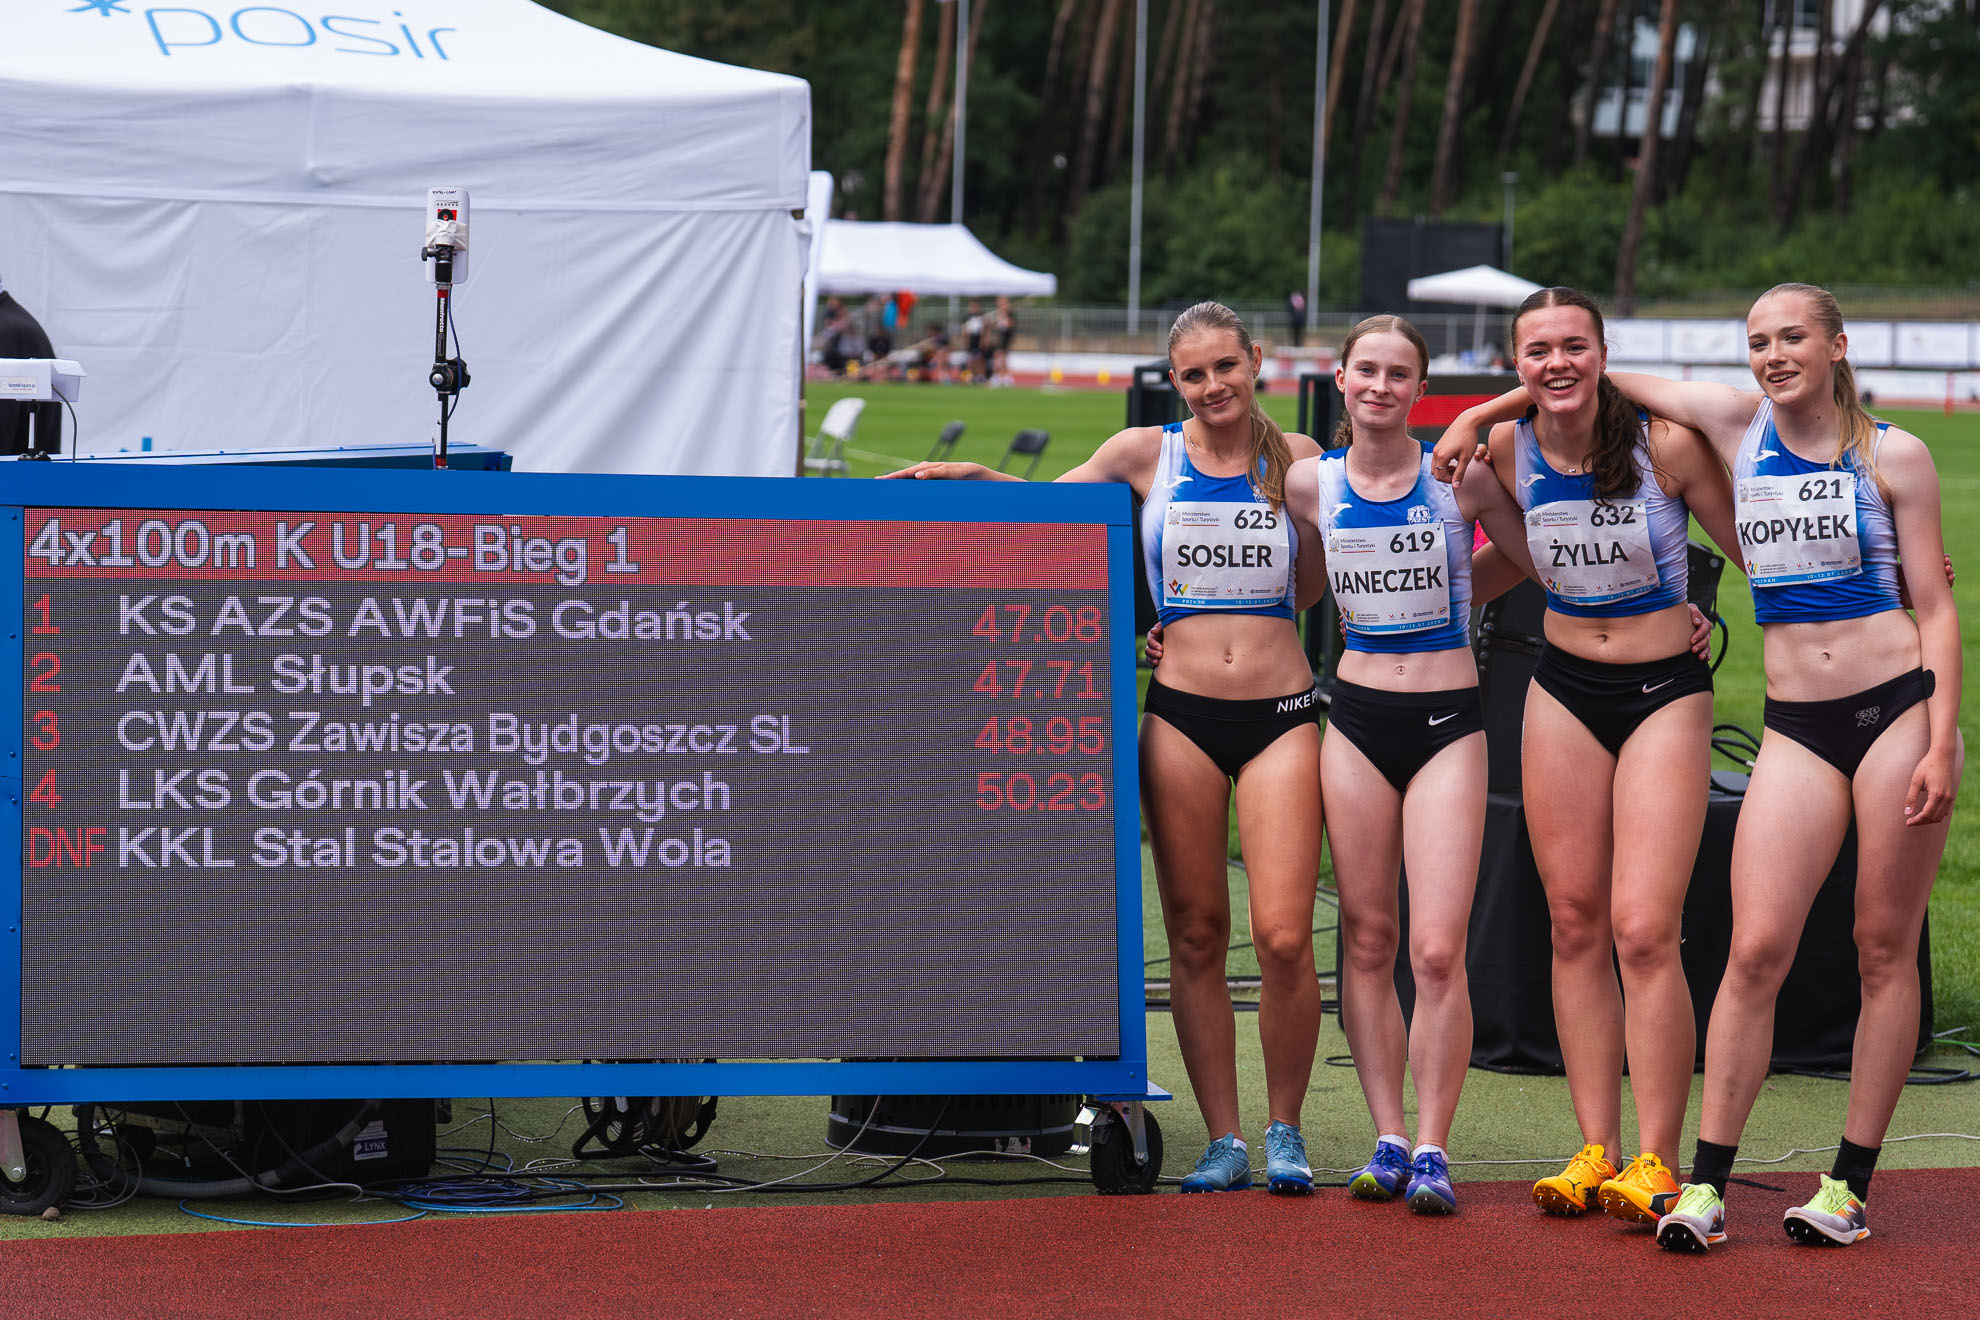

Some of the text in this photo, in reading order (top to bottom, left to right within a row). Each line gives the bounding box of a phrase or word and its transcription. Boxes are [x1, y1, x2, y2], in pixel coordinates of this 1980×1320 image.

[144, 7, 456, 60] posir
[1798, 479, 1844, 501] 621
[1234, 510, 1278, 529] 625
[1591, 505, 1636, 527] 632
[1739, 514, 1852, 546] KOPYŁEK
[29, 518, 641, 586] 4x100m K U18-Bieg 1
[1177, 544, 1273, 568] SOSLER
[1390, 531, 1435, 553] 619
[1549, 538, 1630, 567] ŻYLLA
[1334, 566, 1443, 594] JANECZEK
[31, 594, 1102, 643] 1 KS AZS AWFiS Gdańsk 47.08
[30, 652, 1104, 706] 2 AML Słupsk 47.71
[1277, 693, 1311, 713] NIKE
[31, 710, 1105, 765] 3 CWZS Zawisza Bydgoszcz SL 48.95
[30, 769, 1107, 823] 4 LKS Górnik Wałbrzych 50.23
[29, 827, 732, 867] DNF KKL Stal Stalowa Wola
[364, 1141, 387, 1151] LYNX
